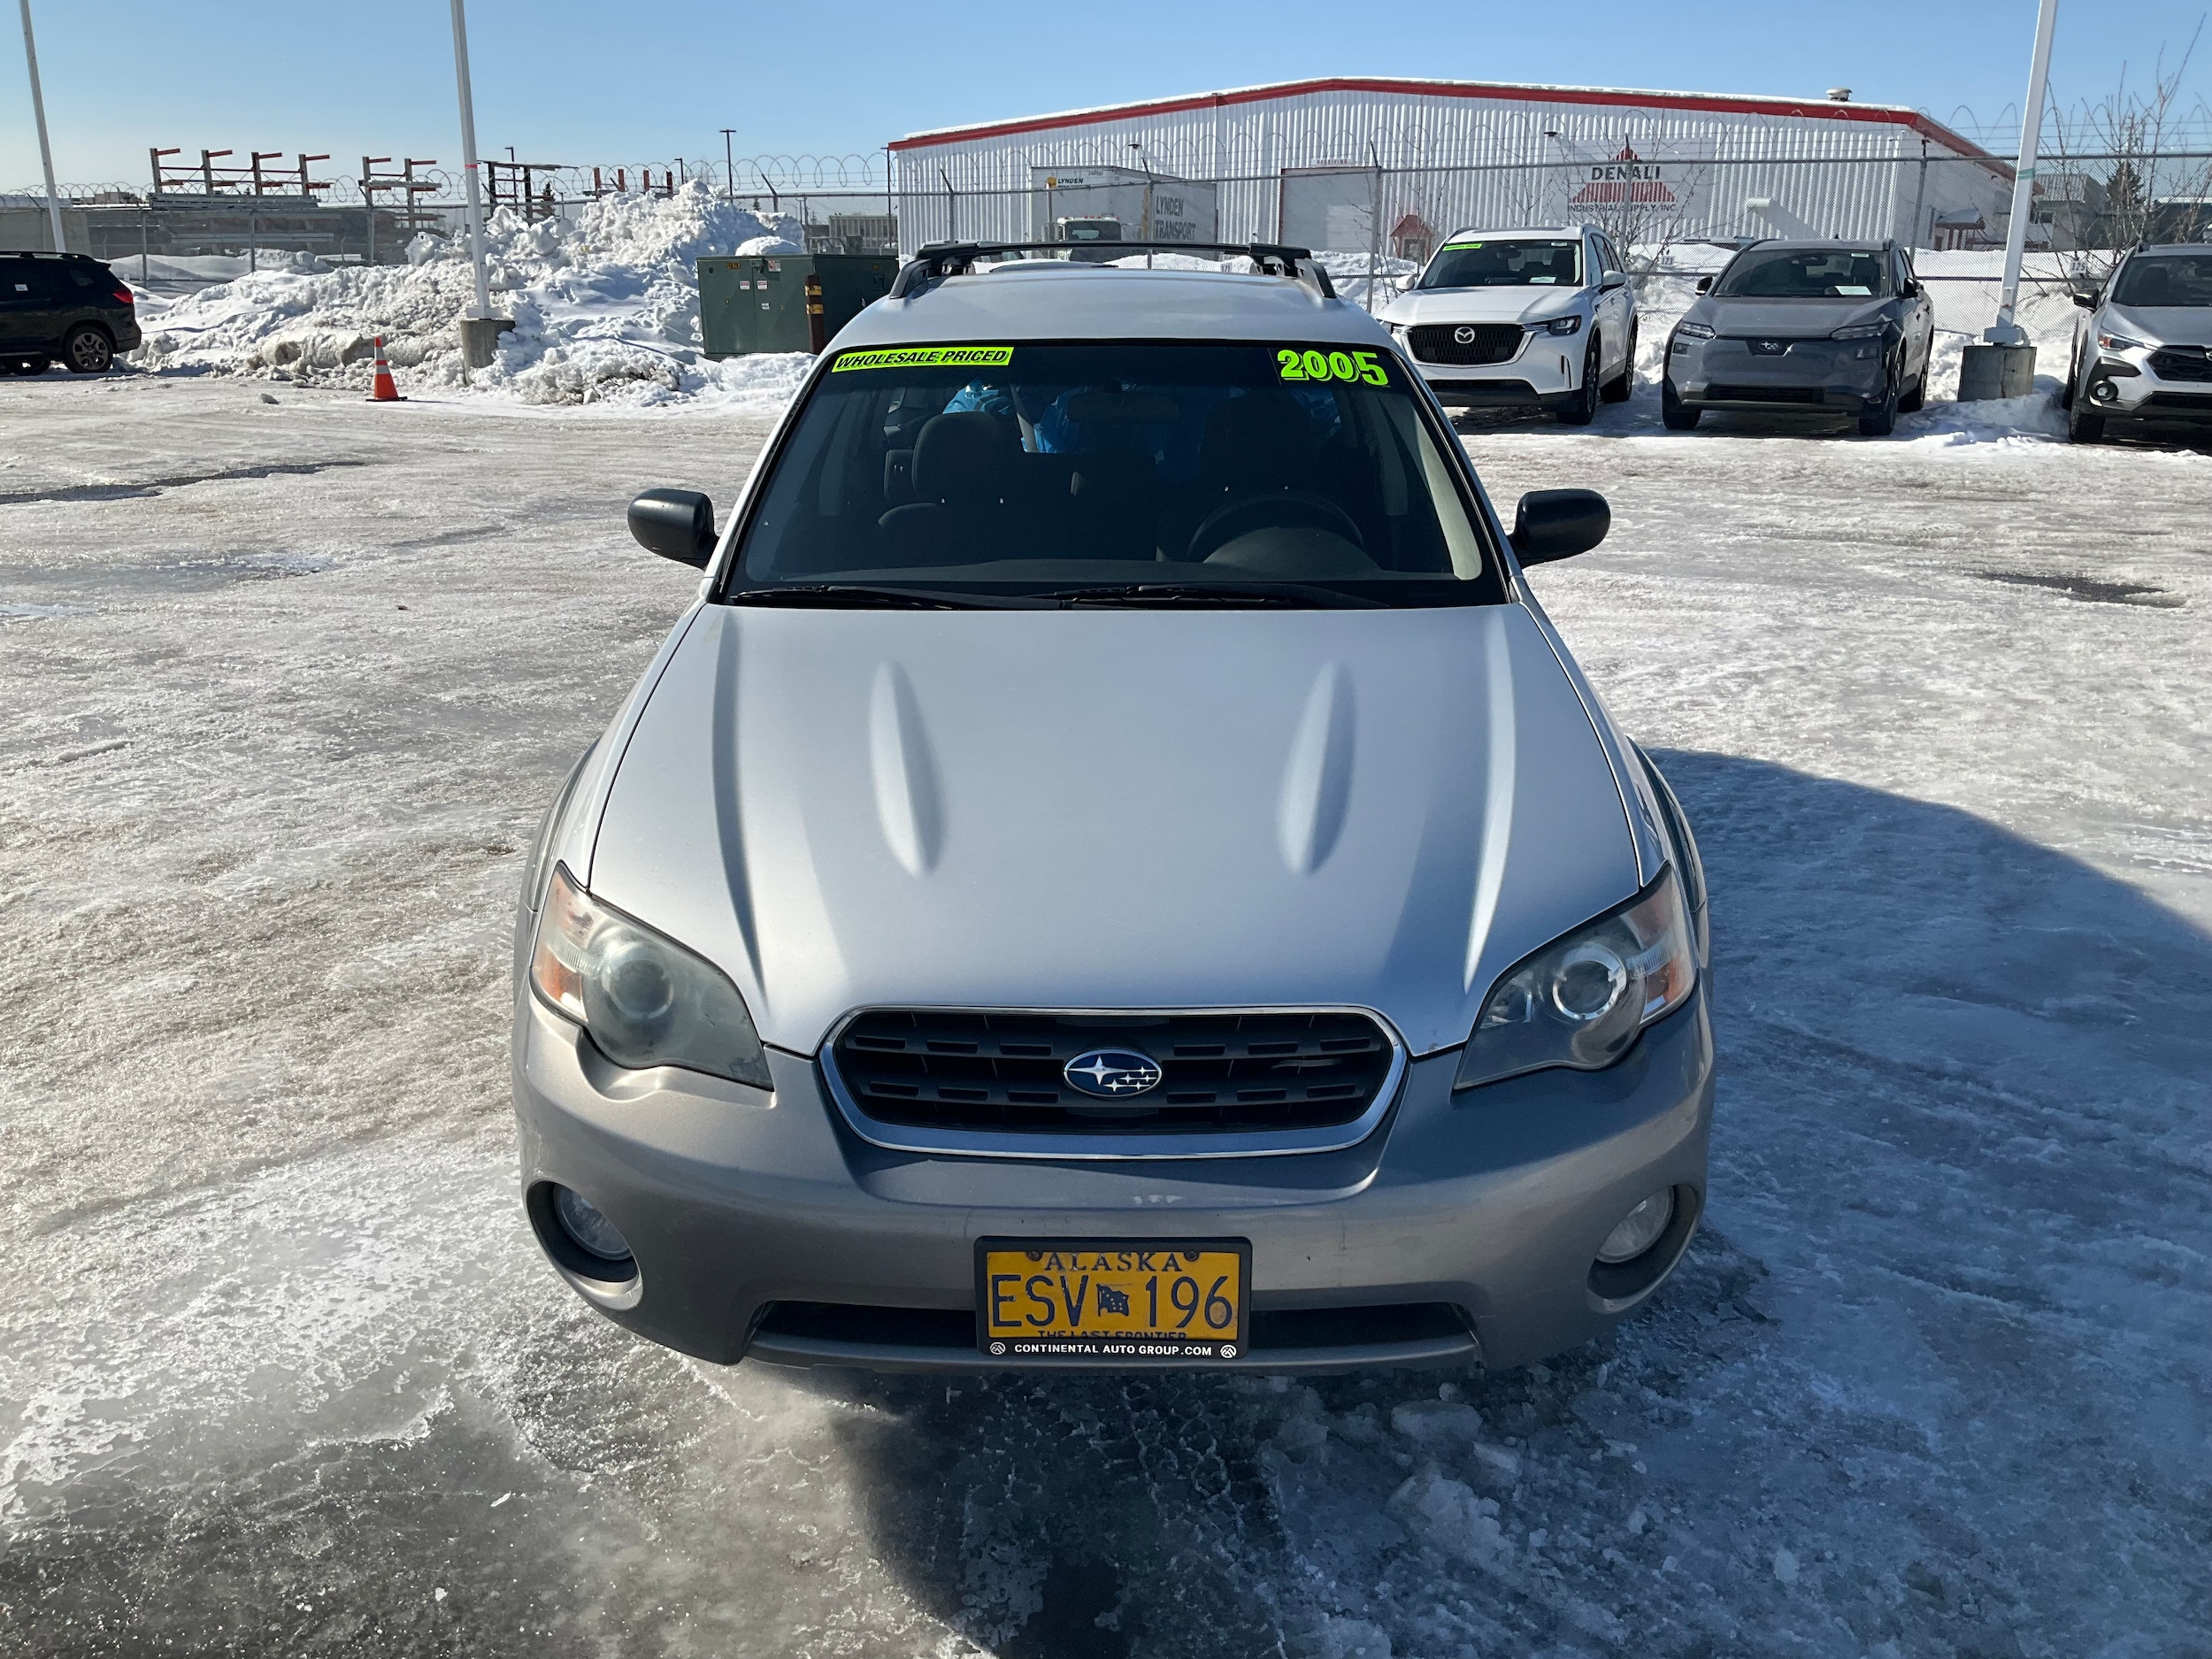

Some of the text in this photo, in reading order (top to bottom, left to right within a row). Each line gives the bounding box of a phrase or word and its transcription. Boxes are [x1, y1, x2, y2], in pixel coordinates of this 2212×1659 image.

[1591, 165, 1661, 180] DENALI
[1156, 196, 1184, 217] LYNDEN
[1568, 204, 1621, 212] INDUSTRIAL
[1156, 219, 1196, 240] TRANSPORT
[1661, 257, 1673, 265] 123
[2070, 262, 2085, 271] 125
[836, 350, 1010, 369] WHOLESALE PRICED
[1277, 349, 1389, 386] 2005
[1044, 1251, 1182, 1272] ALASKA
[991, 1274, 1233, 1330] ESV 196
[1014, 1343, 1099, 1355] CONTINENTAL
[1102, 1344, 1136, 1356] AUTO
